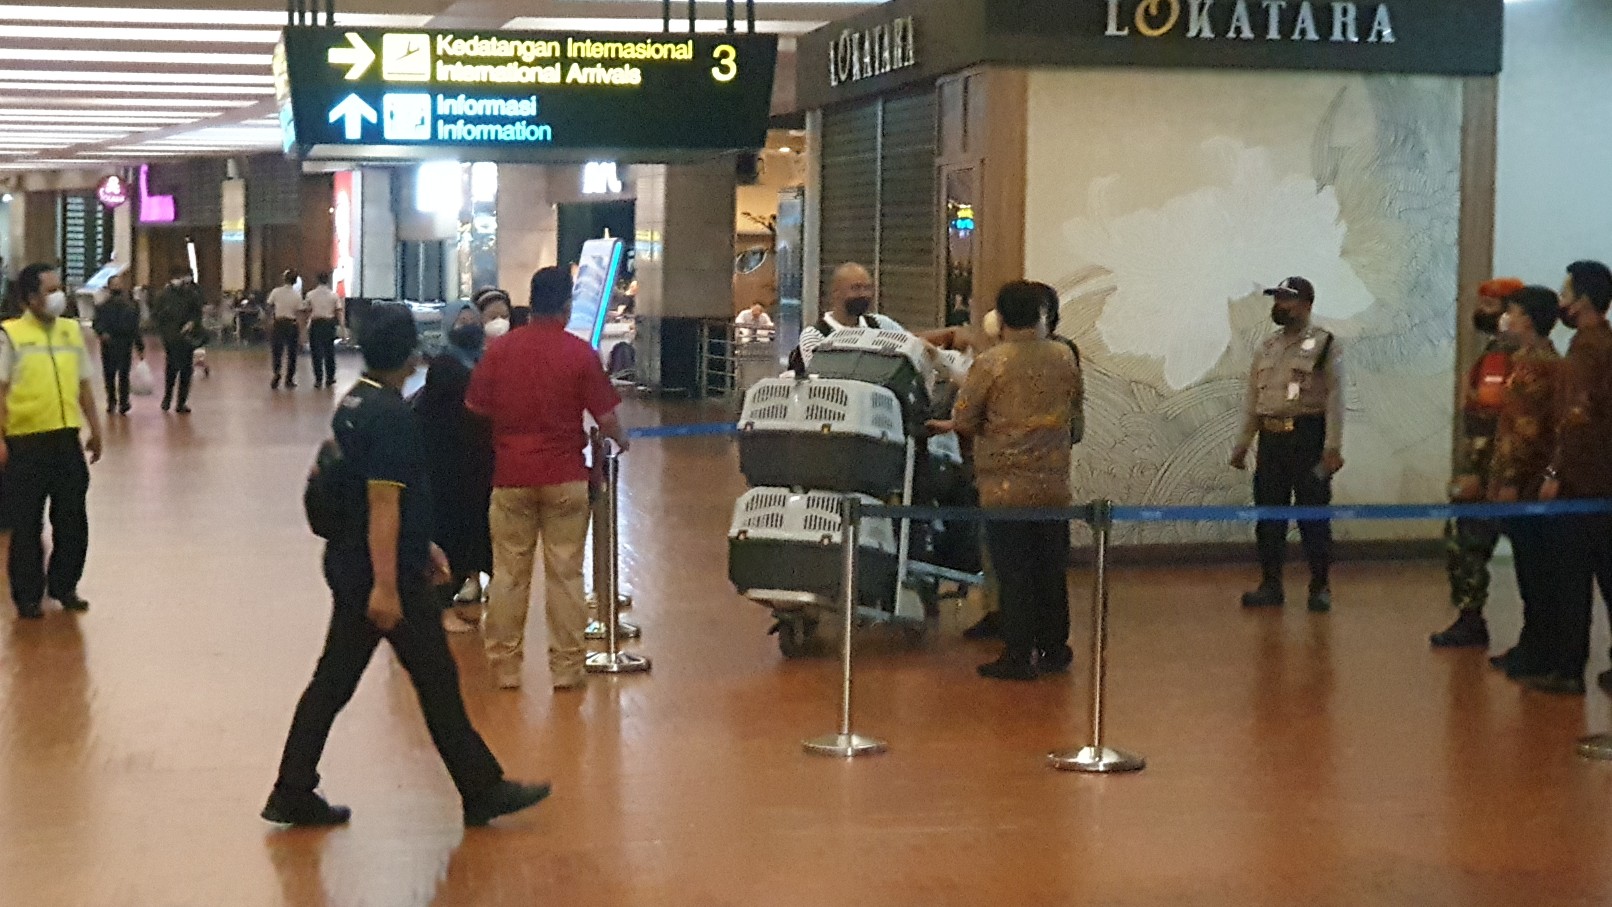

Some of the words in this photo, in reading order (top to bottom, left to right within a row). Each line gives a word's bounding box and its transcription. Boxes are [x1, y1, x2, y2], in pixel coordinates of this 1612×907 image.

[1105, 0, 1396, 43] LOKATARA
[436, 34, 561, 63] Kedatangan
[567, 37, 693, 60] Internasional
[711, 44, 738, 82] 3
[829, 16, 915, 87] LOKATARA
[436, 59, 561, 83] International
[565, 62, 642, 85] Arrivals
[437, 93, 537, 117] Informasi
[437, 119, 552, 141] Information
